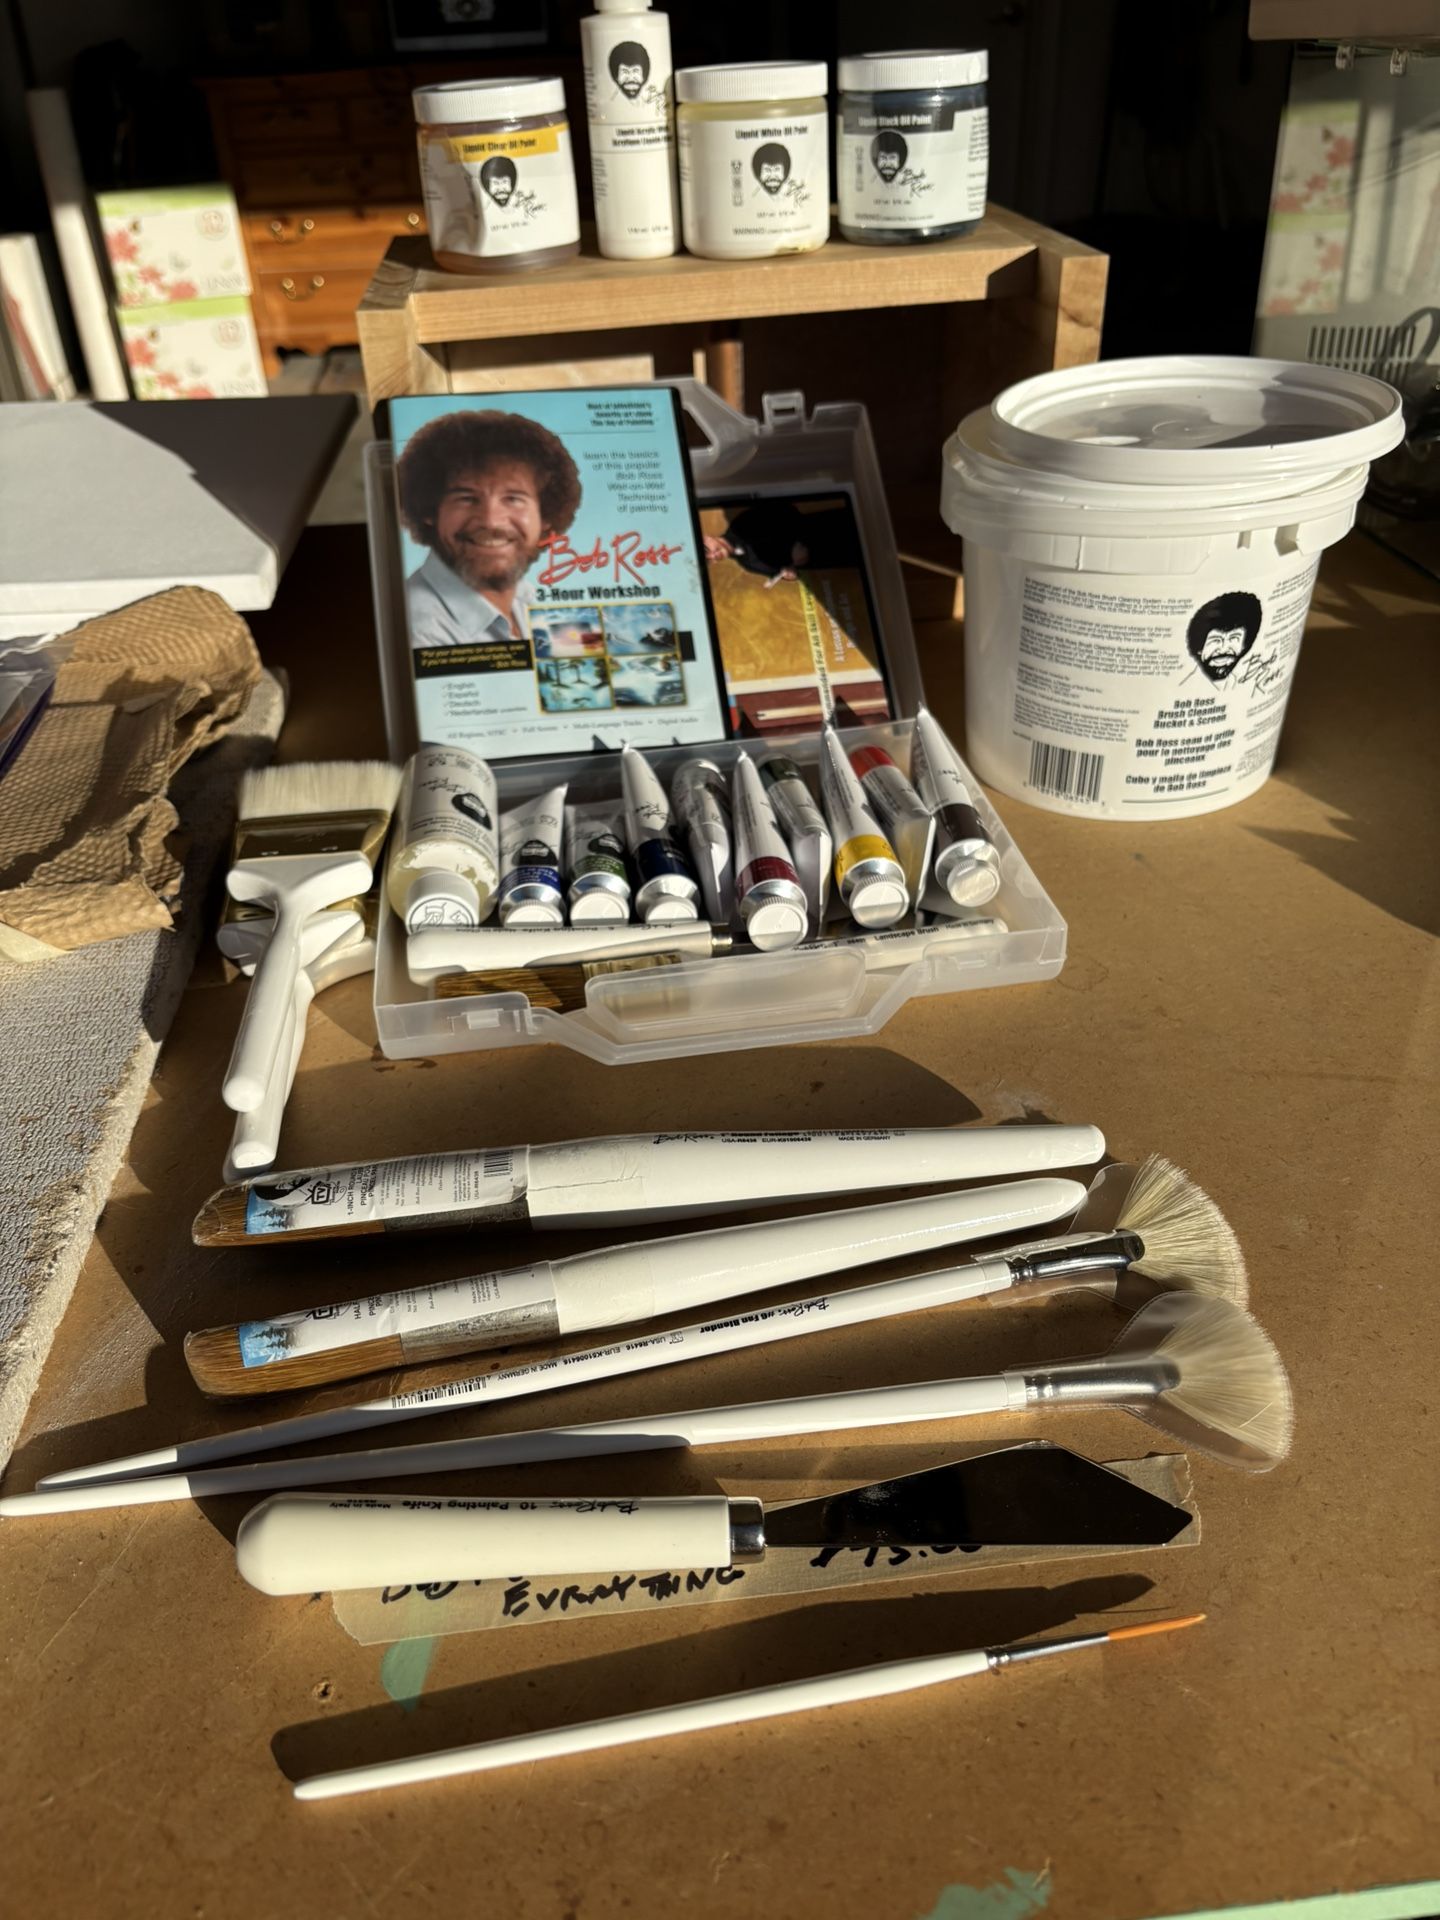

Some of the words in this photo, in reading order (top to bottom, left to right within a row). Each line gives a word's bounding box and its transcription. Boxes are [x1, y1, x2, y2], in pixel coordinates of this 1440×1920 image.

[537, 531, 609, 586] Bob
[610, 531, 683, 586] Ross
[536, 588, 585, 601] 3-Hour
[588, 585, 661, 599] Workshop
[1174, 699, 1192, 709] Bob
[1194, 697, 1216, 708] Ross
[1158, 708, 1185, 720] Brush
[1187, 704, 1227, 718] Cleaning
[1153, 718, 1187, 729] Bucket
[1188, 718, 1195, 727] &
[1196, 713, 1227, 727] Screen
[1135, 737, 1154, 748] Bob
[1155, 737, 1179, 748] Ross
[1136, 748, 1160, 758] pour
[1171, 742, 1216, 757] nettoyage
[1217, 738, 1232, 750] des
[1164, 753, 1207, 766] pinceaux
[1125, 773, 1149, 785] Cubo
[1152, 775, 1158, 786] y
[1186, 771, 1197, 782] de
[1153, 783, 1165, 794] de
[1167, 781, 1185, 791] Bob
[1186, 780, 1207, 790] Ross
[874, 930, 916, 942] Landscape
[917, 926, 939, 936] Brush
[700, 1319, 741, 1333] Blender
[741, 1314, 760, 1324] Fan
[626, 1336, 666, 1351] USA-R6416
[530, 1365, 538, 1374] IN
[539, 1360, 558, 1372] MADE
[497, 1367, 530, 1381] GERMANY
[401, 1500, 442, 1510] Knife
[447, 1500, 509, 1511] Painting
[520, 1501, 537, 1510] 10
